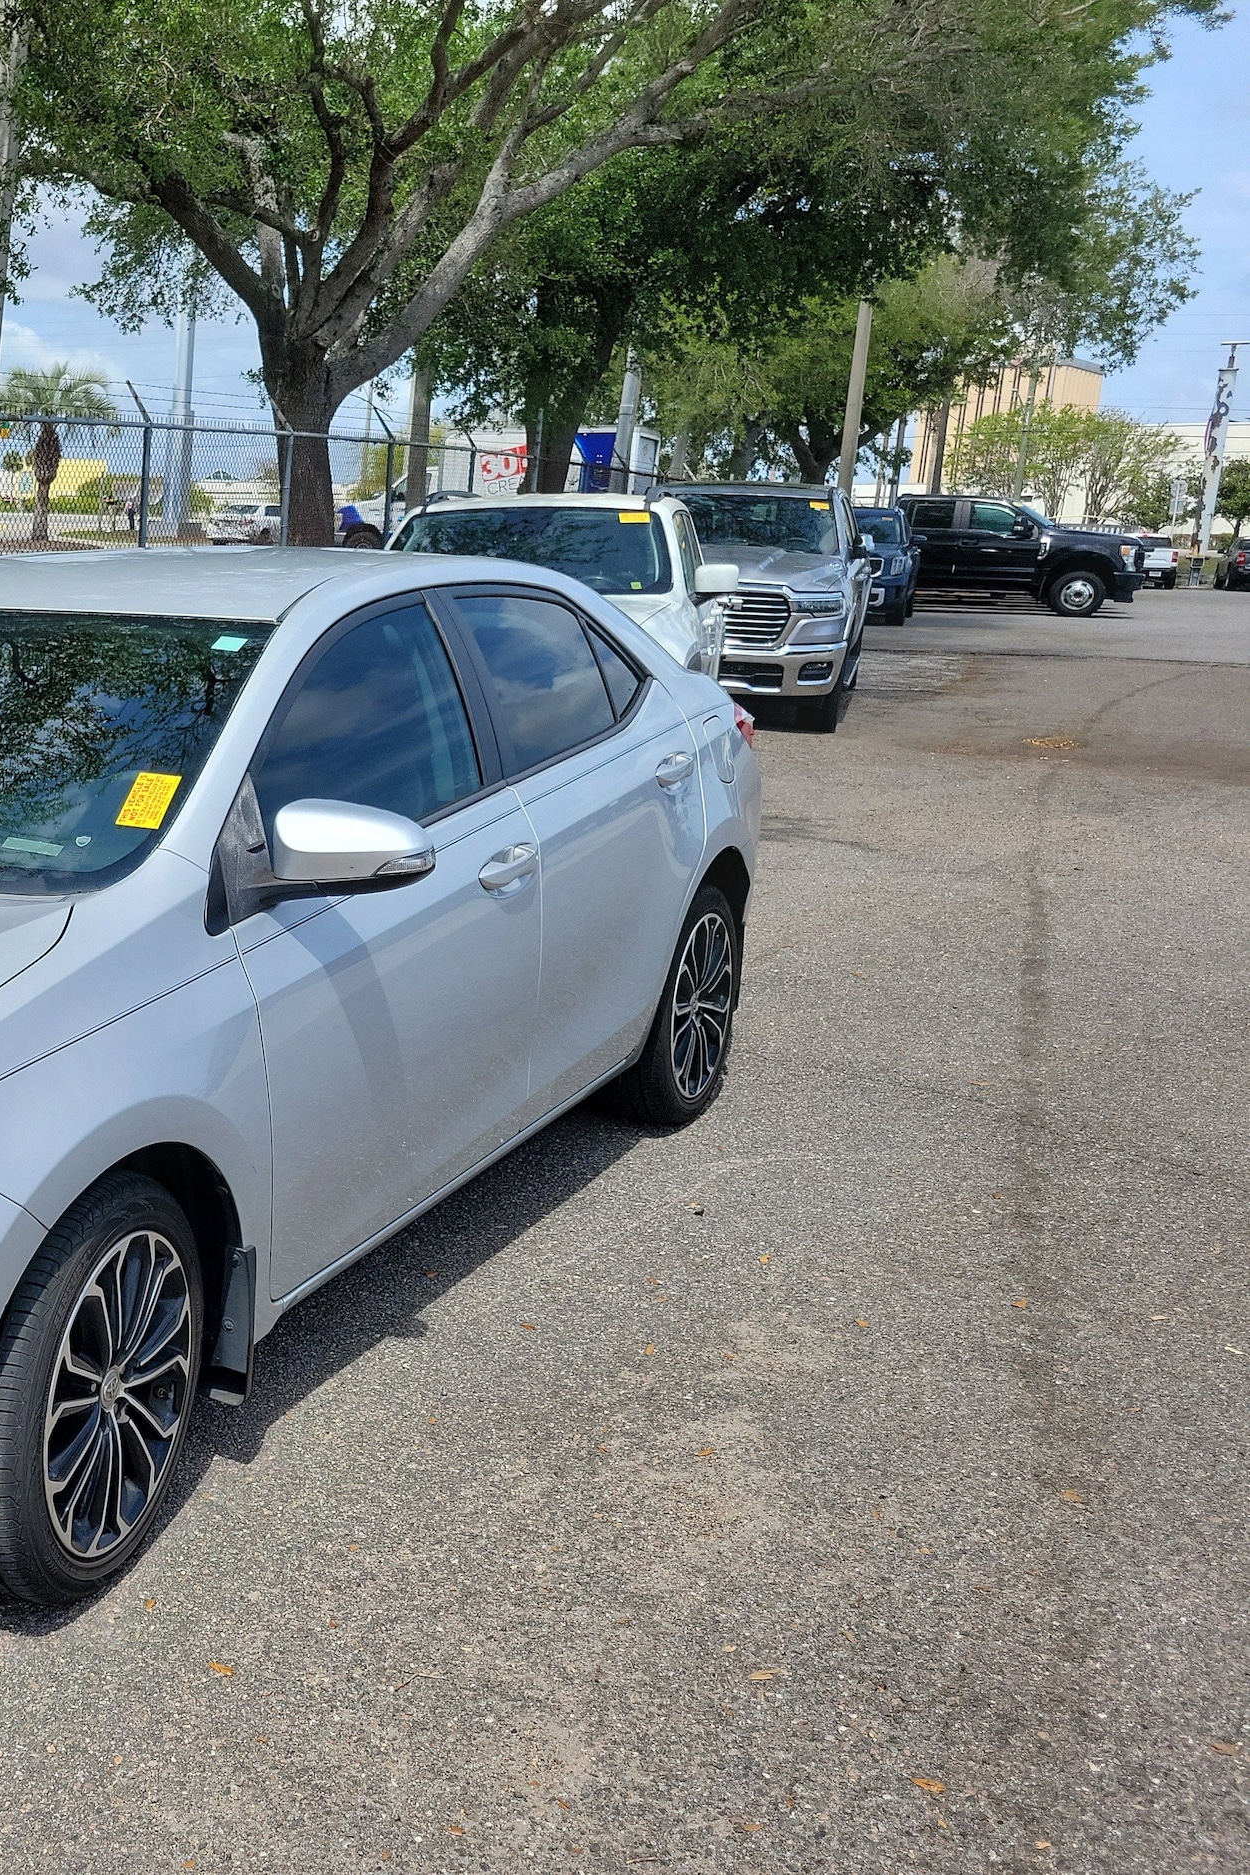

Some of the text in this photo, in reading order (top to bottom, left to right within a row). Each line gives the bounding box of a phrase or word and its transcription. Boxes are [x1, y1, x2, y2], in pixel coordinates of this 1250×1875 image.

[119, 808, 131, 823] THIS
[126, 781, 145, 808] VEHICLE
[128, 777, 155, 822] NOT FOR SALE
